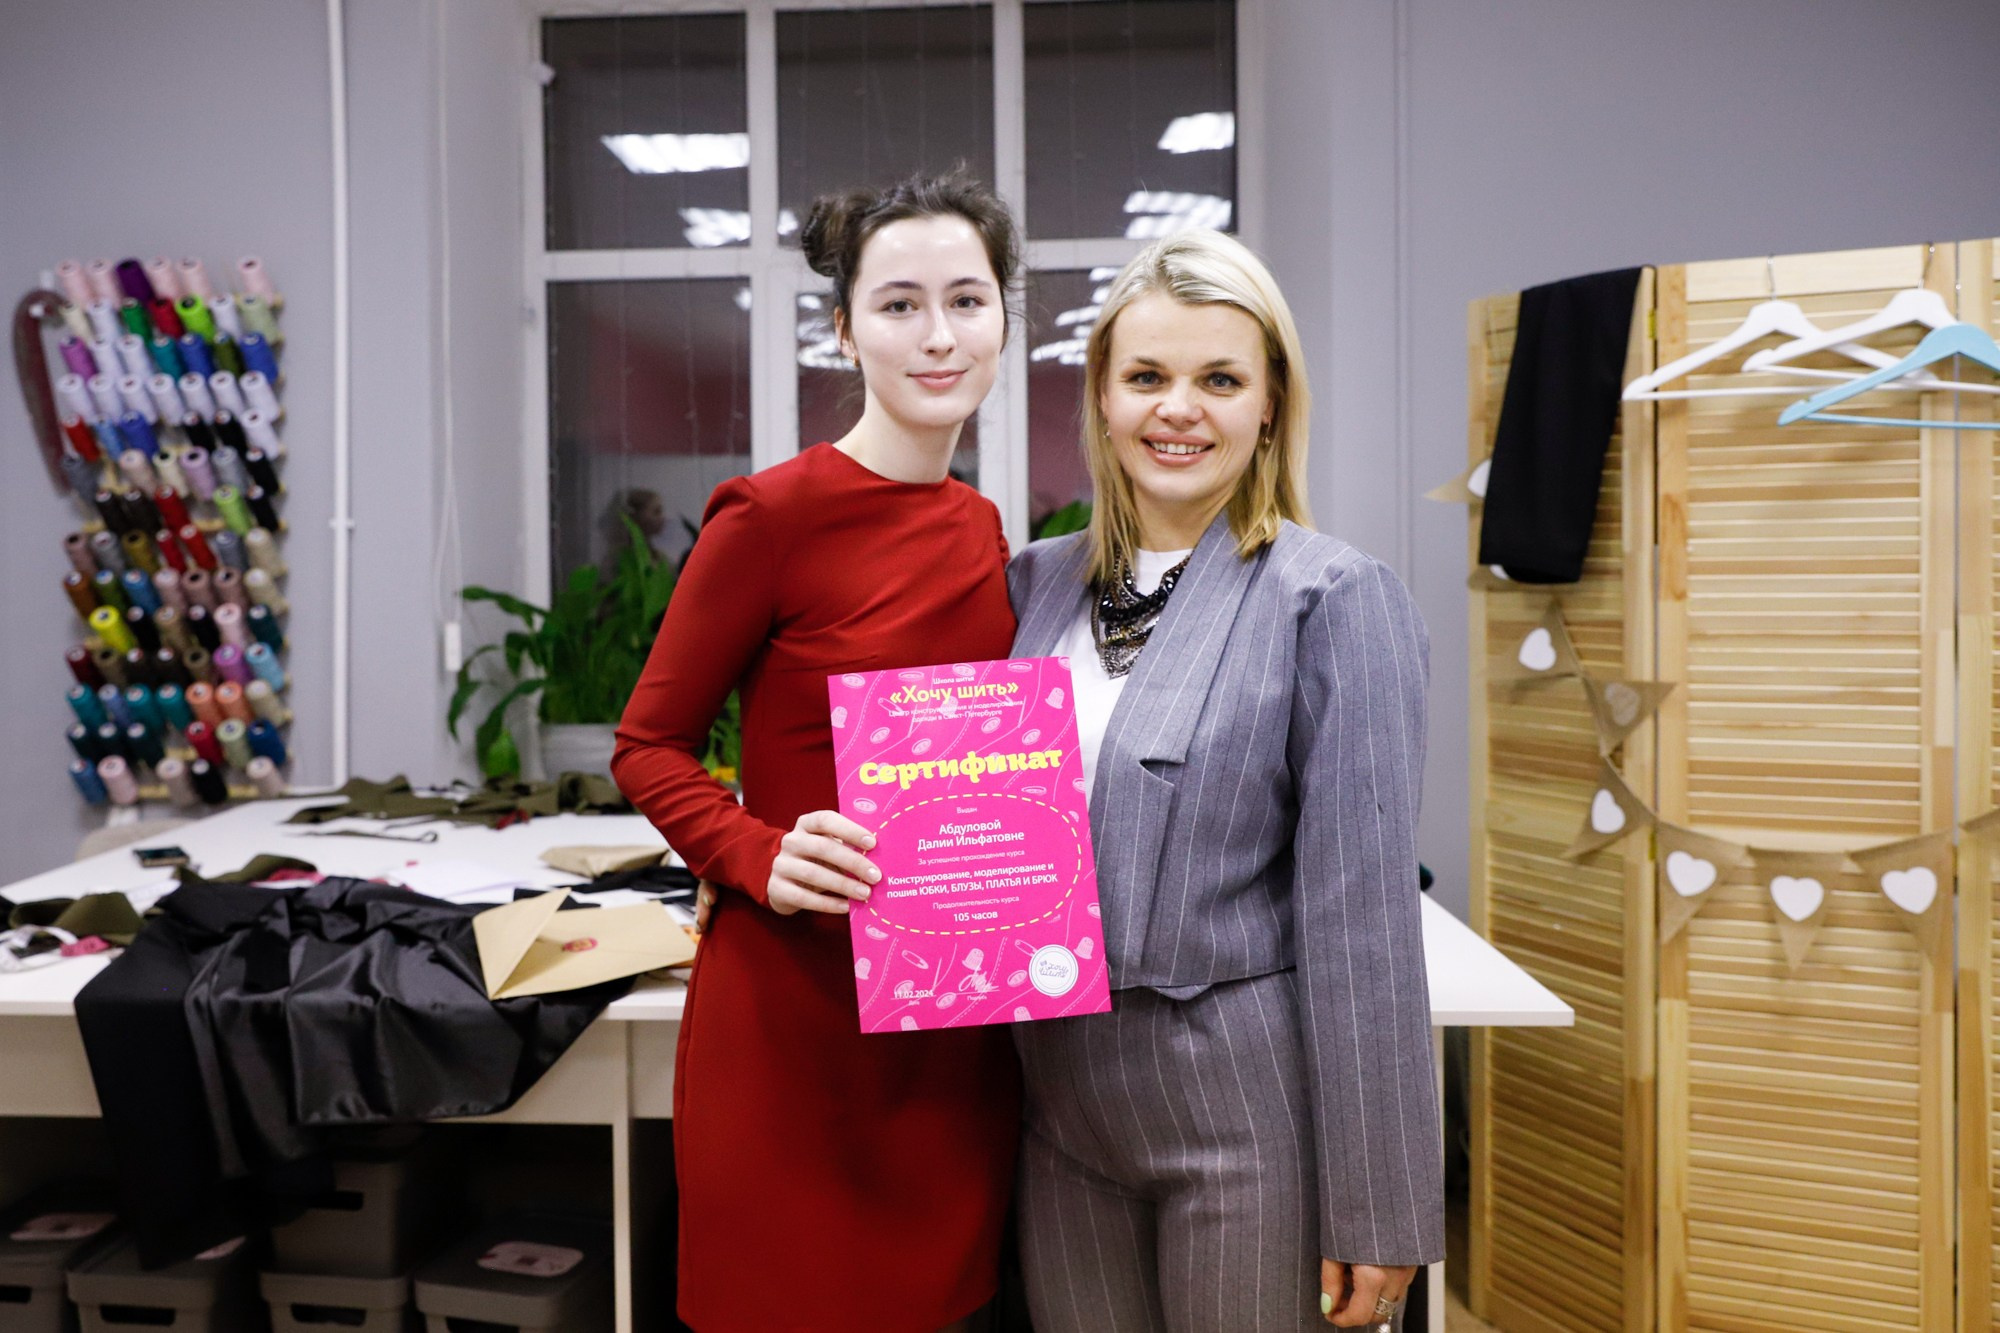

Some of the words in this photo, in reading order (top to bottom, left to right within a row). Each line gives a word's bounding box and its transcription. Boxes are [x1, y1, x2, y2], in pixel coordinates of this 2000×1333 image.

[933, 677, 955, 685] Школа
[955, 675, 975, 683] шитья
[889, 684, 953, 705] «Хочу
[957, 682, 1019, 699] шить»
[911, 704, 967, 716] конструиния
[858, 749, 1063, 790] Сертификат
[956, 806, 978, 814] Выдан
[938, 819, 1002, 836] Абдуловой
[917, 838, 954, 852] Далии
[955, 831, 1025, 846] Ильфатовне
[918, 858, 927, 866] За
[927, 855, 960, 866] успешное
[961, 851, 1006, 863] прохождение
[1006, 849, 1025, 858] курса
[887, 869, 973, 886] Конструирование,
[974, 864, 1047, 879] моделирование
[1047, 862, 1054, 871] и
[886, 887, 918, 898] пошив
[919, 884, 950, 896] ЮБКИ,
[950, 881, 985, 893] БЛУЗЫ,
[985, 877, 1022, 889] ПЛАТЬЯ
[1022, 876, 1031, 885] И
[1032, 873, 1059, 884] БРЮК
[932, 898, 1000, 910] Продолжительность
[1001, 896, 1020, 904] курса
[953, 912, 970, 922] 105
[971, 911, 999, 920] часов
